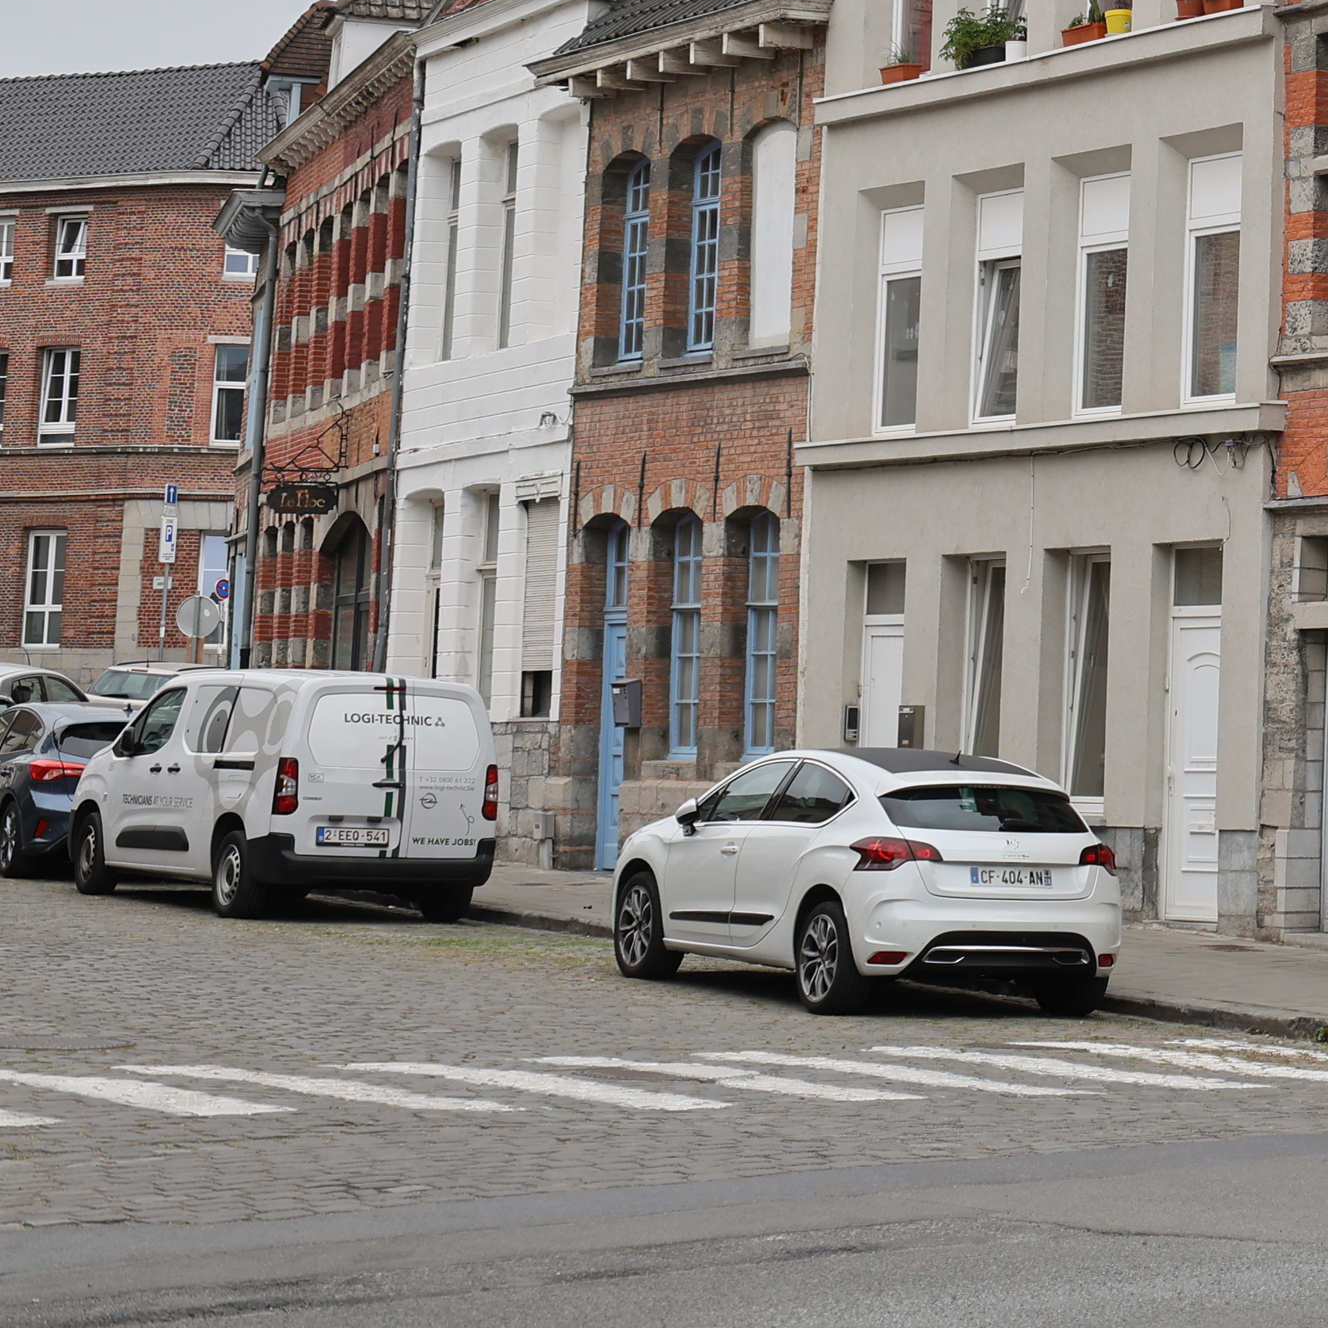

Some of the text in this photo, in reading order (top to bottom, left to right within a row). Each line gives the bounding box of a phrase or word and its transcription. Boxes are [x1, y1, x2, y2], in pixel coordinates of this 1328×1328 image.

[344, 713, 433, 727] LOGI-TECHNIC
[412, 837, 424, 845] WE
[427, 837, 449, 846] HAVE
[980, 870, 1043, 885] CF-404-AN
